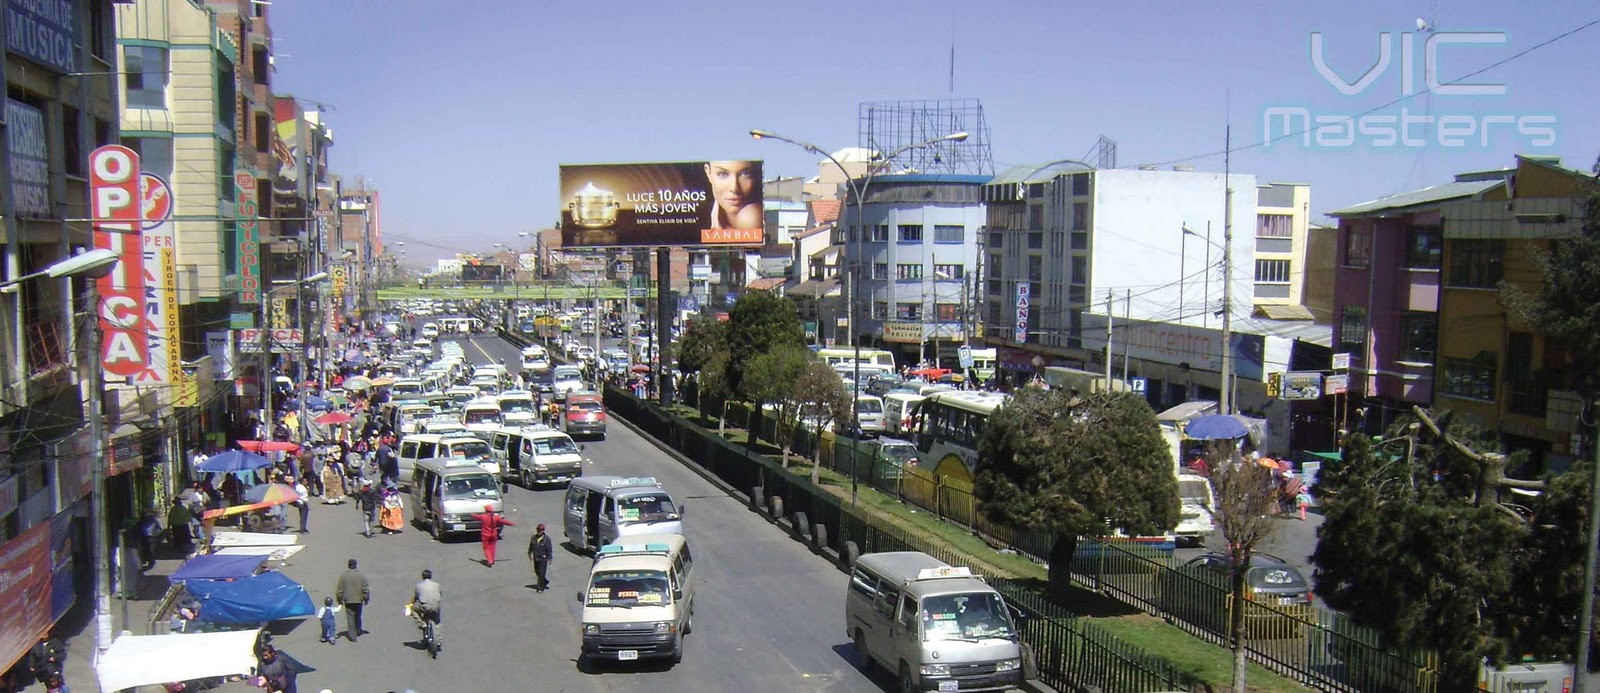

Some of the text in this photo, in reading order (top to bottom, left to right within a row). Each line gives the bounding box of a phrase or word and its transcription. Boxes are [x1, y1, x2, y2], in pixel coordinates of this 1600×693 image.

[61, 1, 73, 32] DE
[7, 9, 75, 73] MÚSICA
[627, 189, 707, 202] LUCE 10 AÑOS
[634, 201, 658, 213] MÁS
[144, 236, 173, 247] PER
[704, 230, 760, 240] YANBAL
[239, 192, 259, 302] FUJICOLOR
[94, 149, 141, 363] OPTICA
[165, 252, 179, 382] VIRGEN DE COPACABANA
[961, 350, 969, 359] P
[1135, 380, 1142, 390] P
